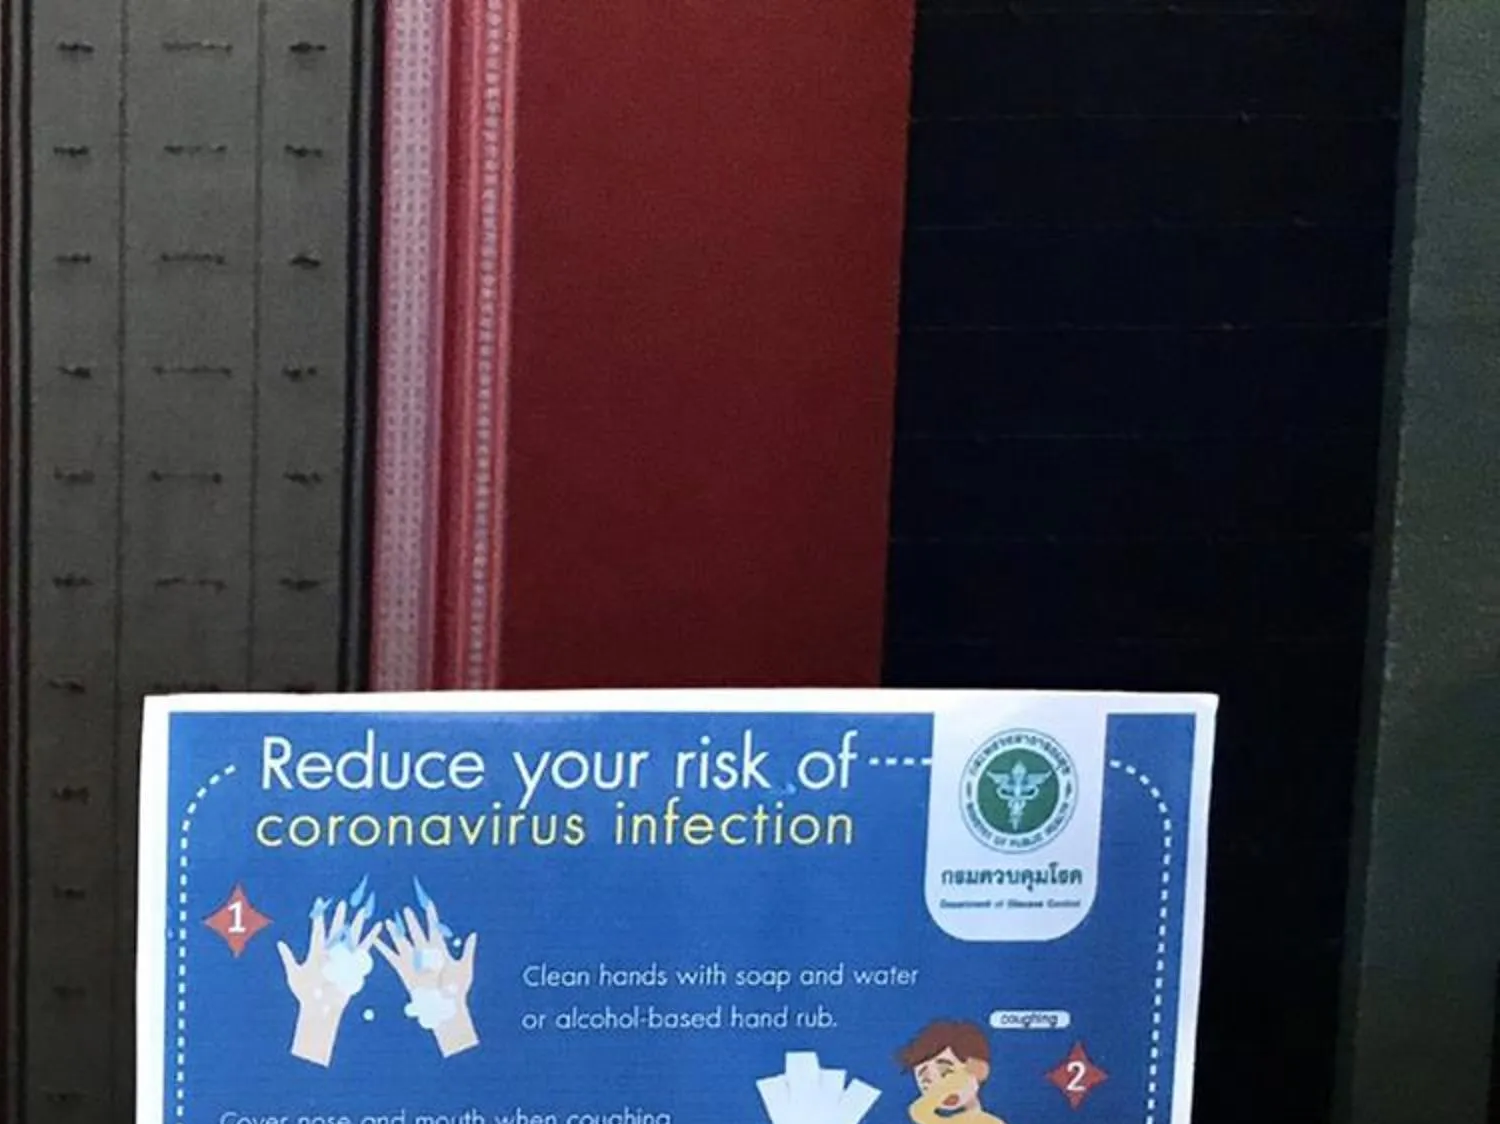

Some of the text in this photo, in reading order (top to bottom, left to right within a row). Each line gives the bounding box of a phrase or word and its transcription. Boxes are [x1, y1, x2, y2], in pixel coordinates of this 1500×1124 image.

[261, 728, 859, 810] Reduce your risk of
[255, 796, 853, 847] coronavirus infection
[941, 861, 1083, 892] กรมควบคุมโรค
[227, 900, 247, 934] 1
[522, 962, 919, 992] Clean hands with soap and water
[521, 1004, 838, 1030] or alcohol-based hand rub.
[1065, 1061, 1088, 1092] 2
